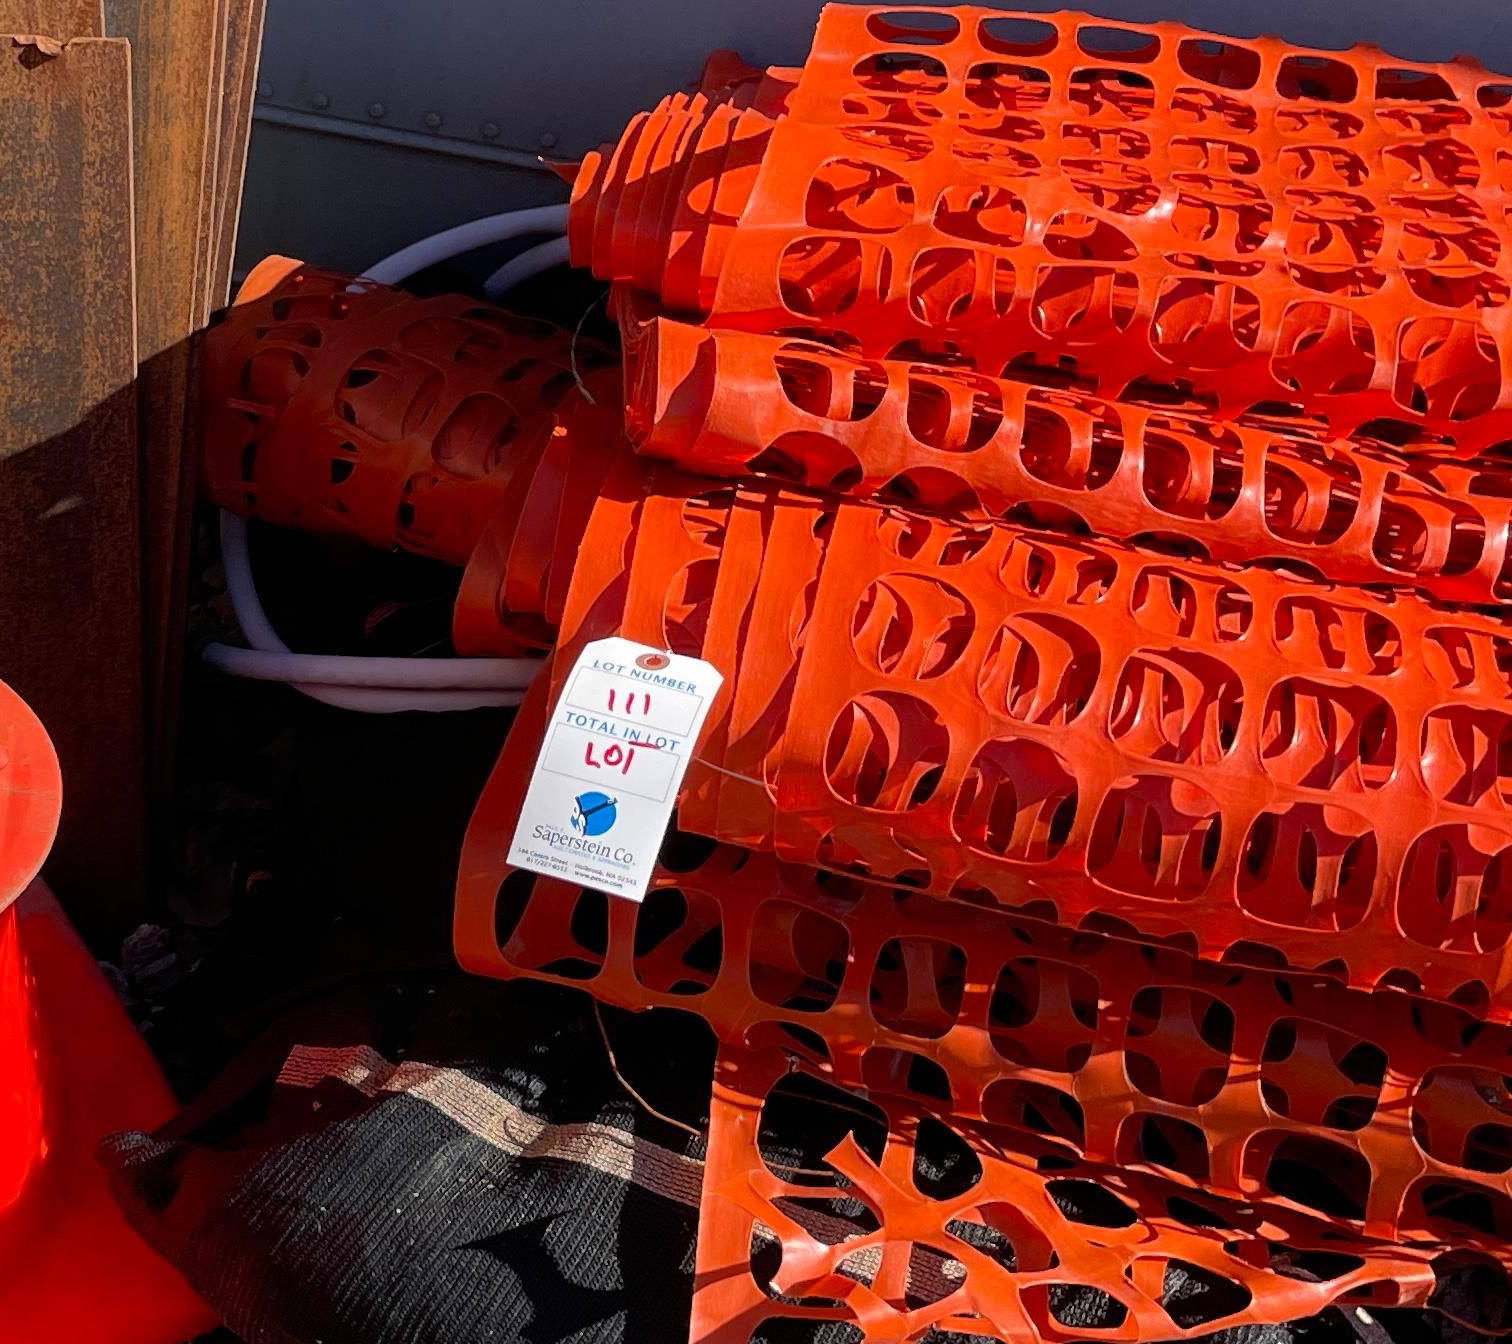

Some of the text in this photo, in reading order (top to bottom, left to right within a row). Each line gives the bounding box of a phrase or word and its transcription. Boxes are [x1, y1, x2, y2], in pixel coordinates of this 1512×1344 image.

[593, 659, 697, 694] LOT NUMBER
[607, 689, 651, 716] 111
[566, 711, 681, 752] TOTAL IN LOT
[532, 824, 610, 858] Saperstein
[614, 847, 636, 866] Co.
